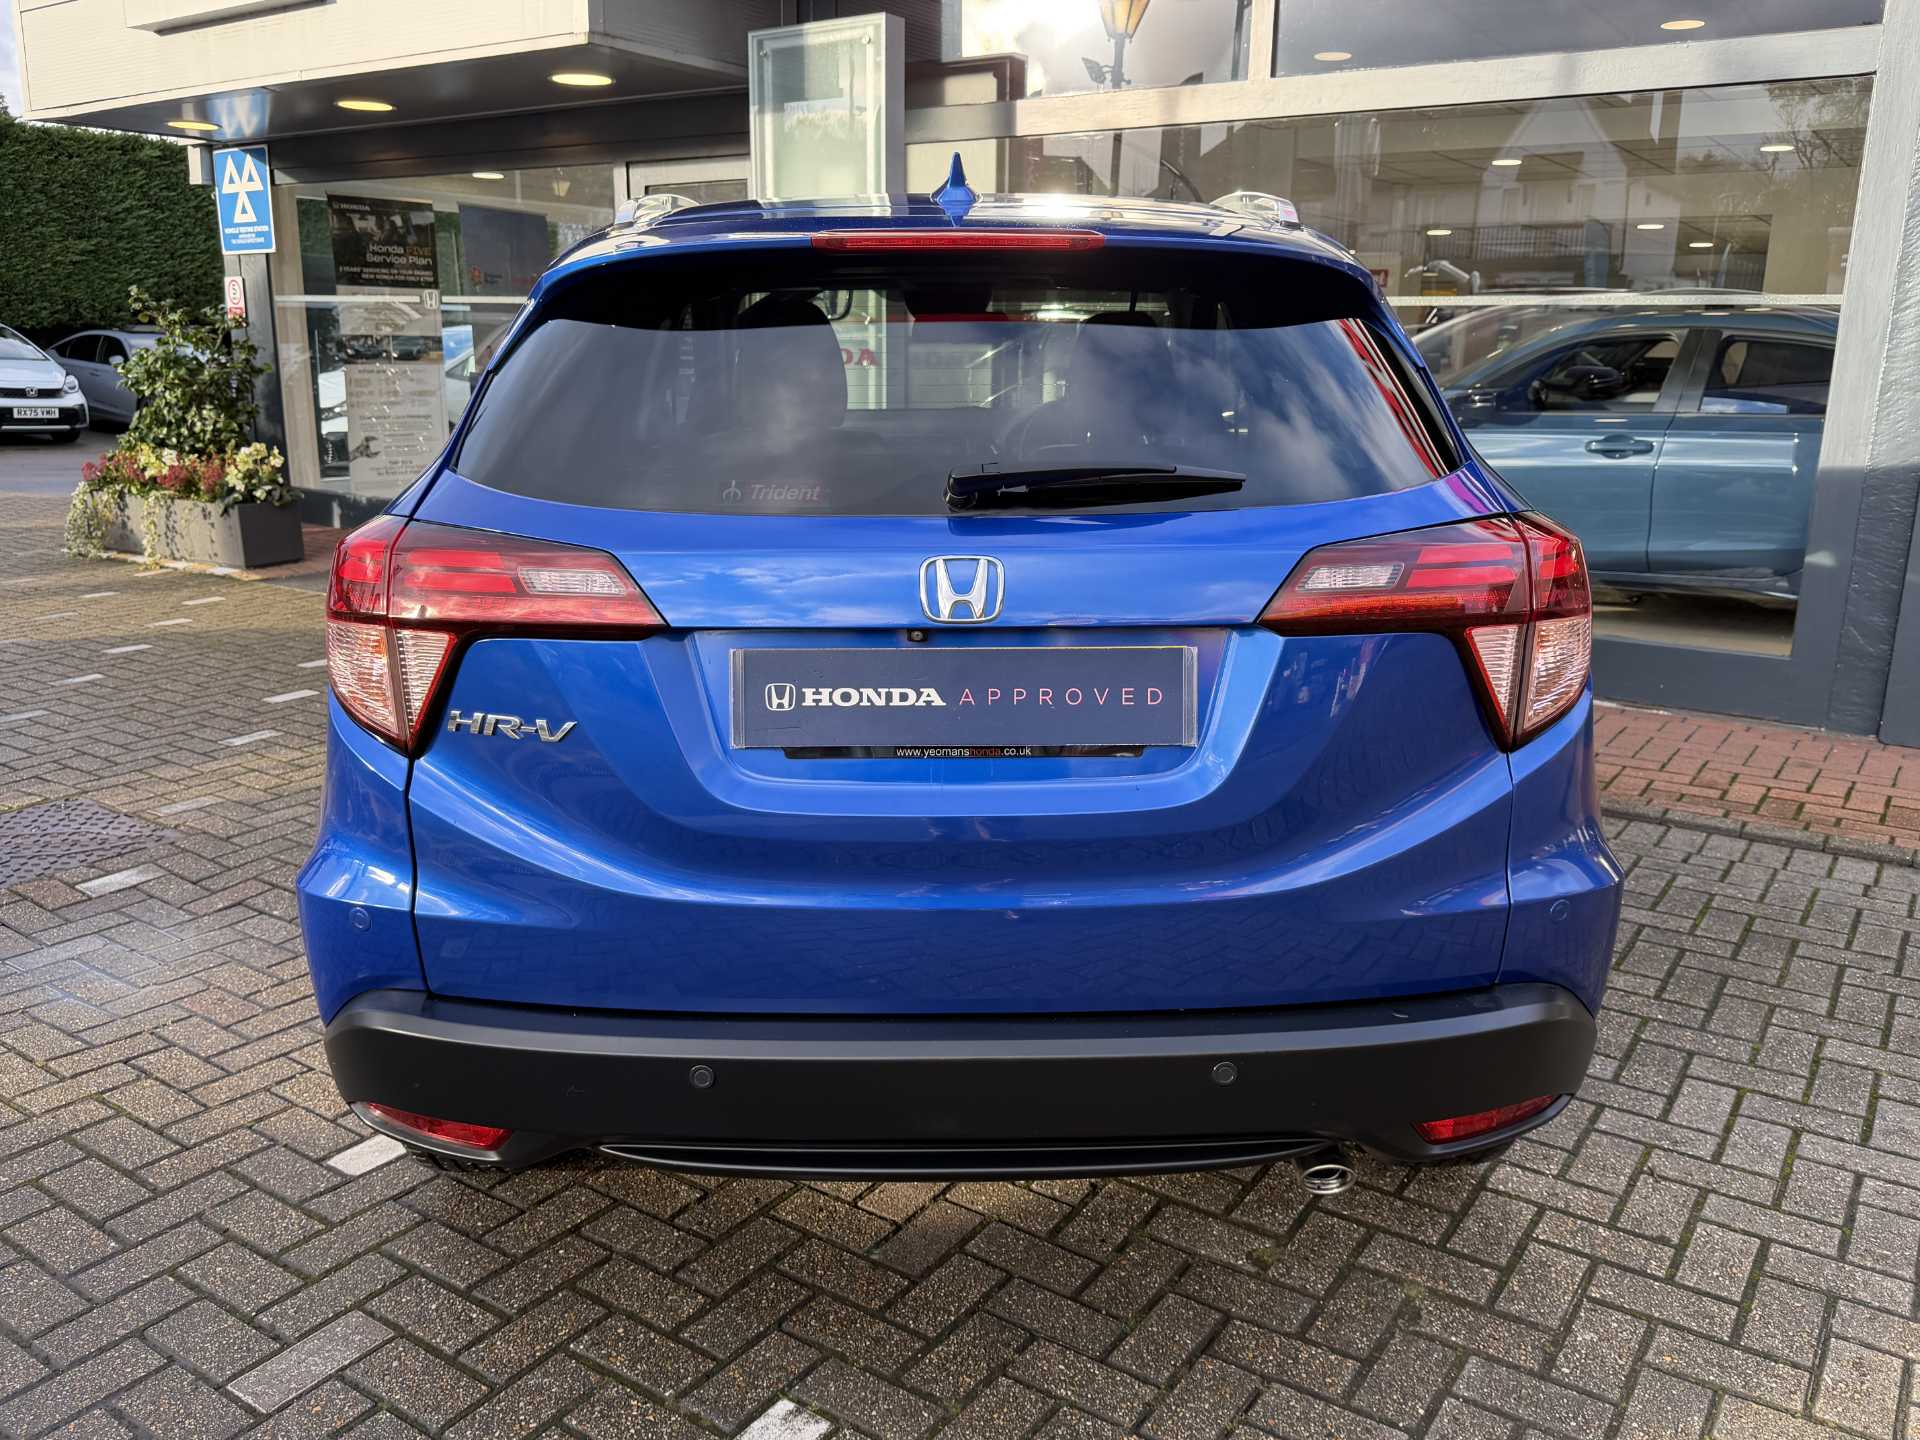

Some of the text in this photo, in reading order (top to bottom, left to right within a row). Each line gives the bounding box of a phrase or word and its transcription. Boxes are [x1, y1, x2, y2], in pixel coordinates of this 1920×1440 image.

[368, 243, 432, 256] Honda FIVE
[366, 253, 432, 266] Service Plan
[751, 484, 821, 501] Trident
[801, 687, 947, 707] HONDA
[959, 687, 1164, 706] APPROVED
[447, 710, 578, 743] HR-V
[896, 745, 1032, 759] www.yeomanshonda.co.uk
